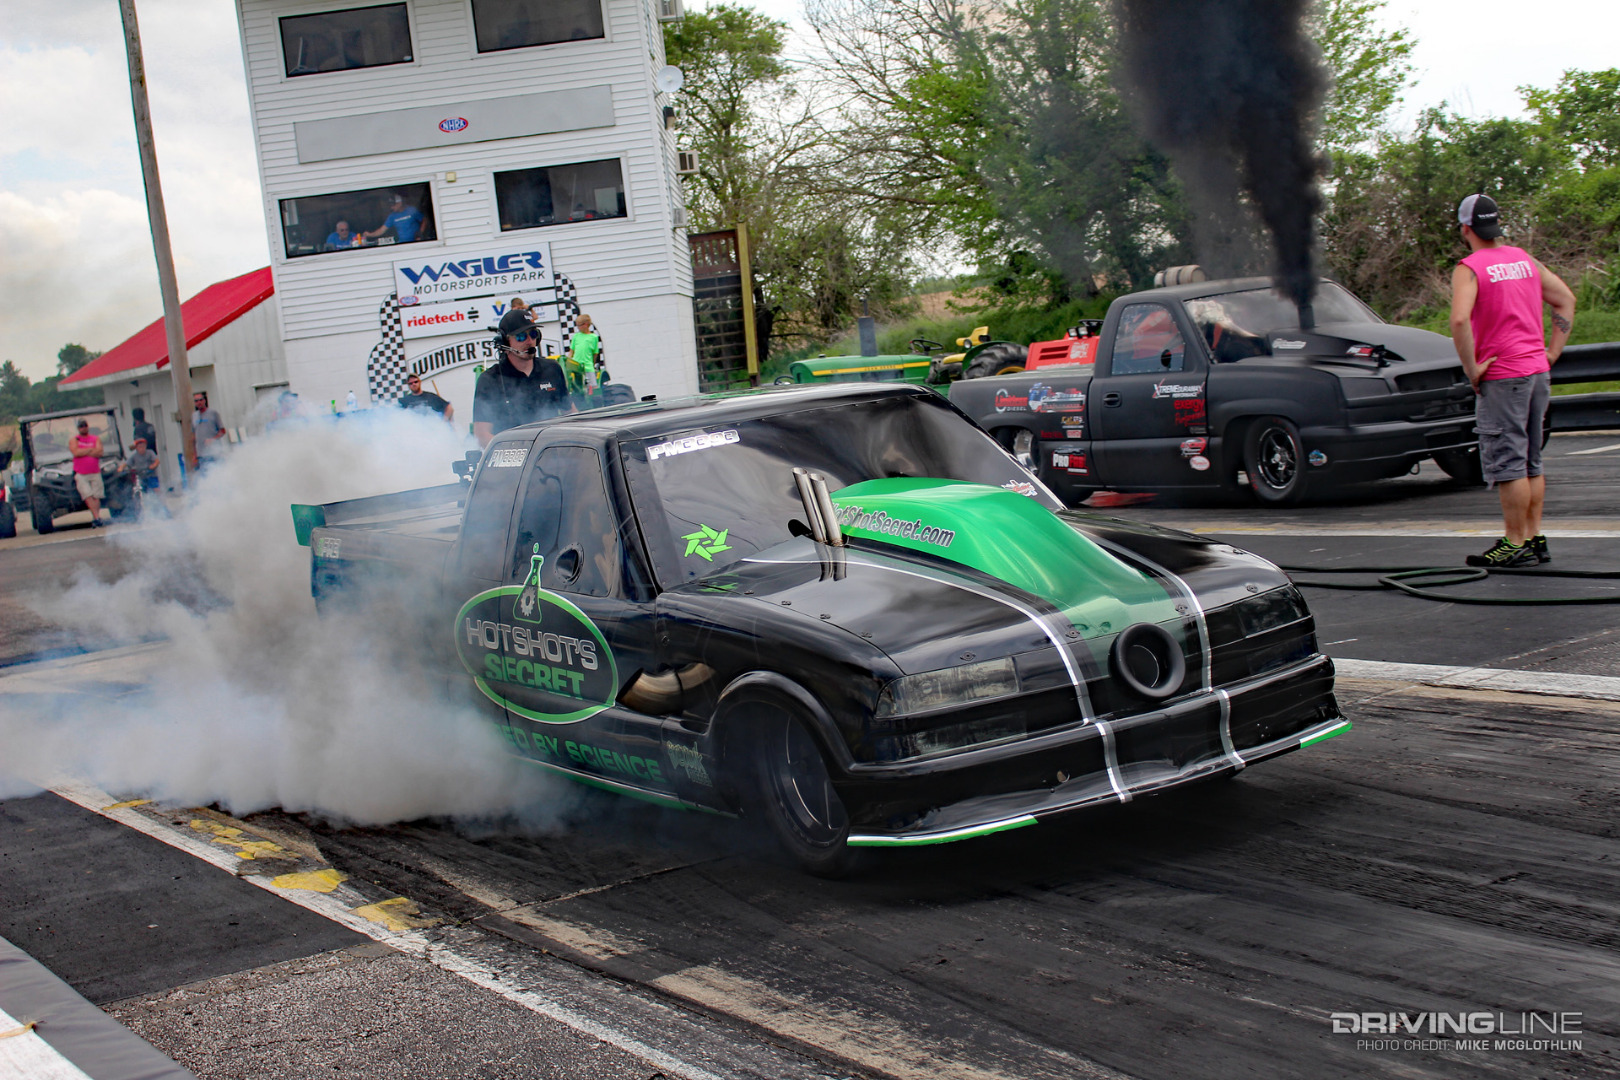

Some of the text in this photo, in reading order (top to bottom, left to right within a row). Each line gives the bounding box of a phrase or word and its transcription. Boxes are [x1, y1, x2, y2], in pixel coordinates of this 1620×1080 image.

[440, 118, 467, 131] NHRA
[400, 251, 545, 285] WAGLER
[413, 275, 508, 296] MOTORSPORTS
[512, 270, 546, 283] PARK
[1486, 260, 1534, 283] SECURITY
[407, 311, 465, 328] ridetech
[412, 339, 494, 377] WINNER'S
[648, 430, 741, 460] PM3393
[484, 652, 585, 700] SECRET
[532, 732, 561, 758] BY
[565, 740, 667, 783] SCIENCE
